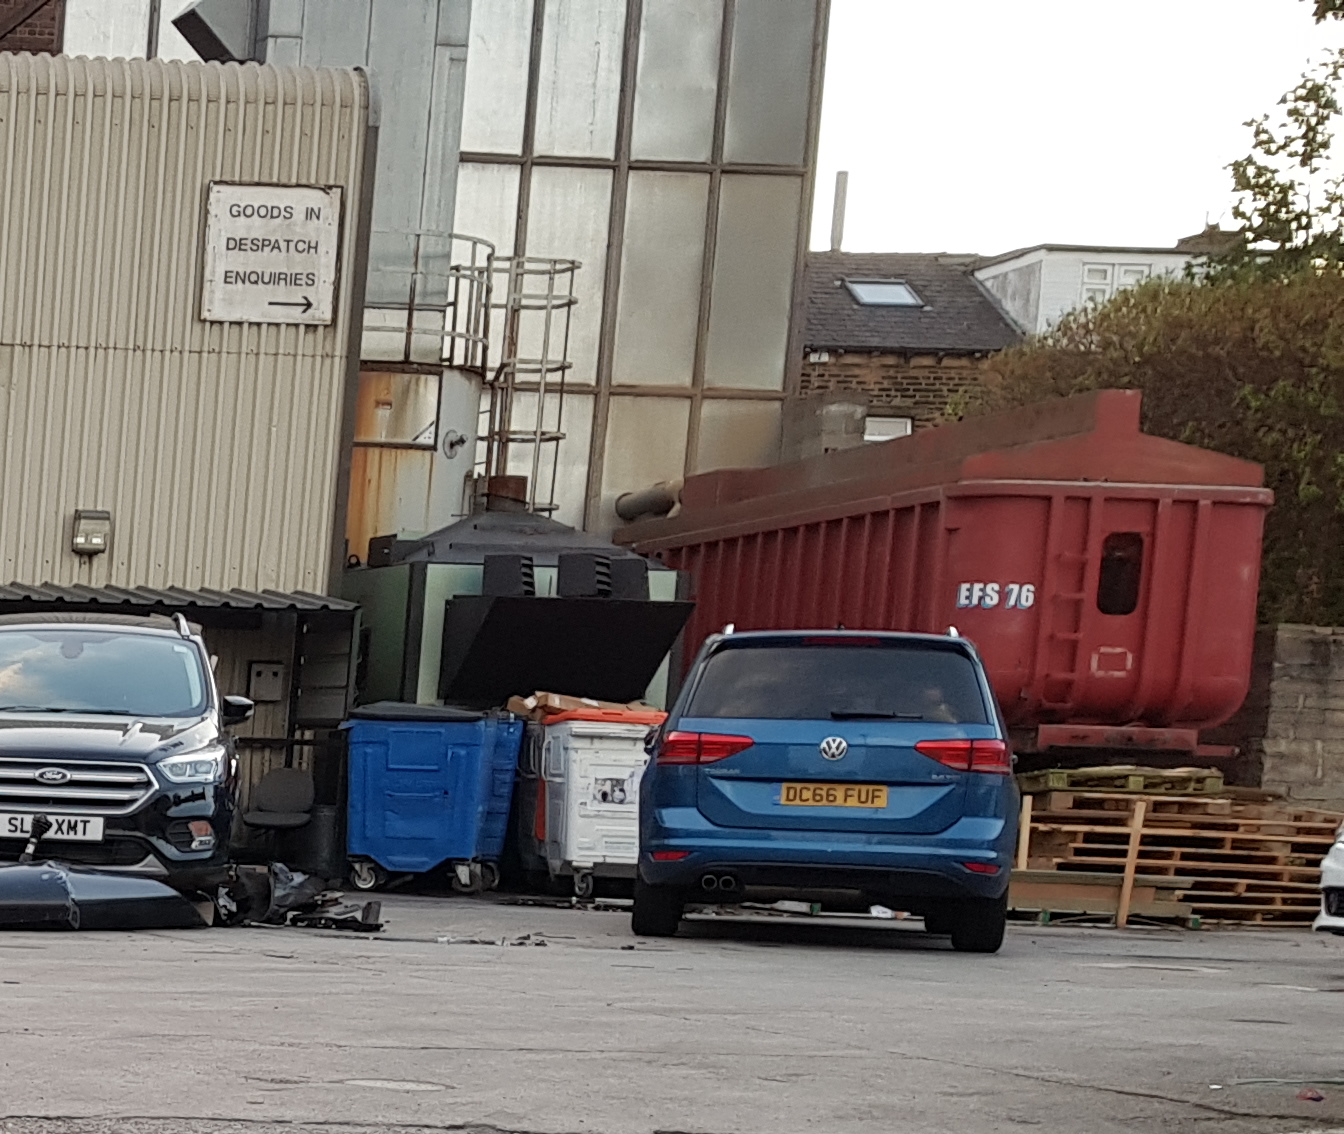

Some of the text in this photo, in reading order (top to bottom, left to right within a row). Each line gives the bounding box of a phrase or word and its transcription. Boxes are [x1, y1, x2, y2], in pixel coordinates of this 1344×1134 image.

[229, 204, 322, 221] GOODS IN
[225, 237, 319, 255] DESPATCH
[223, 270, 316, 287] ENQUIRIES
[957, 582, 1035, 609] EFS 76
[785, 786, 884, 804] DC66 FUF
[54, 819, 91, 836] XMT
